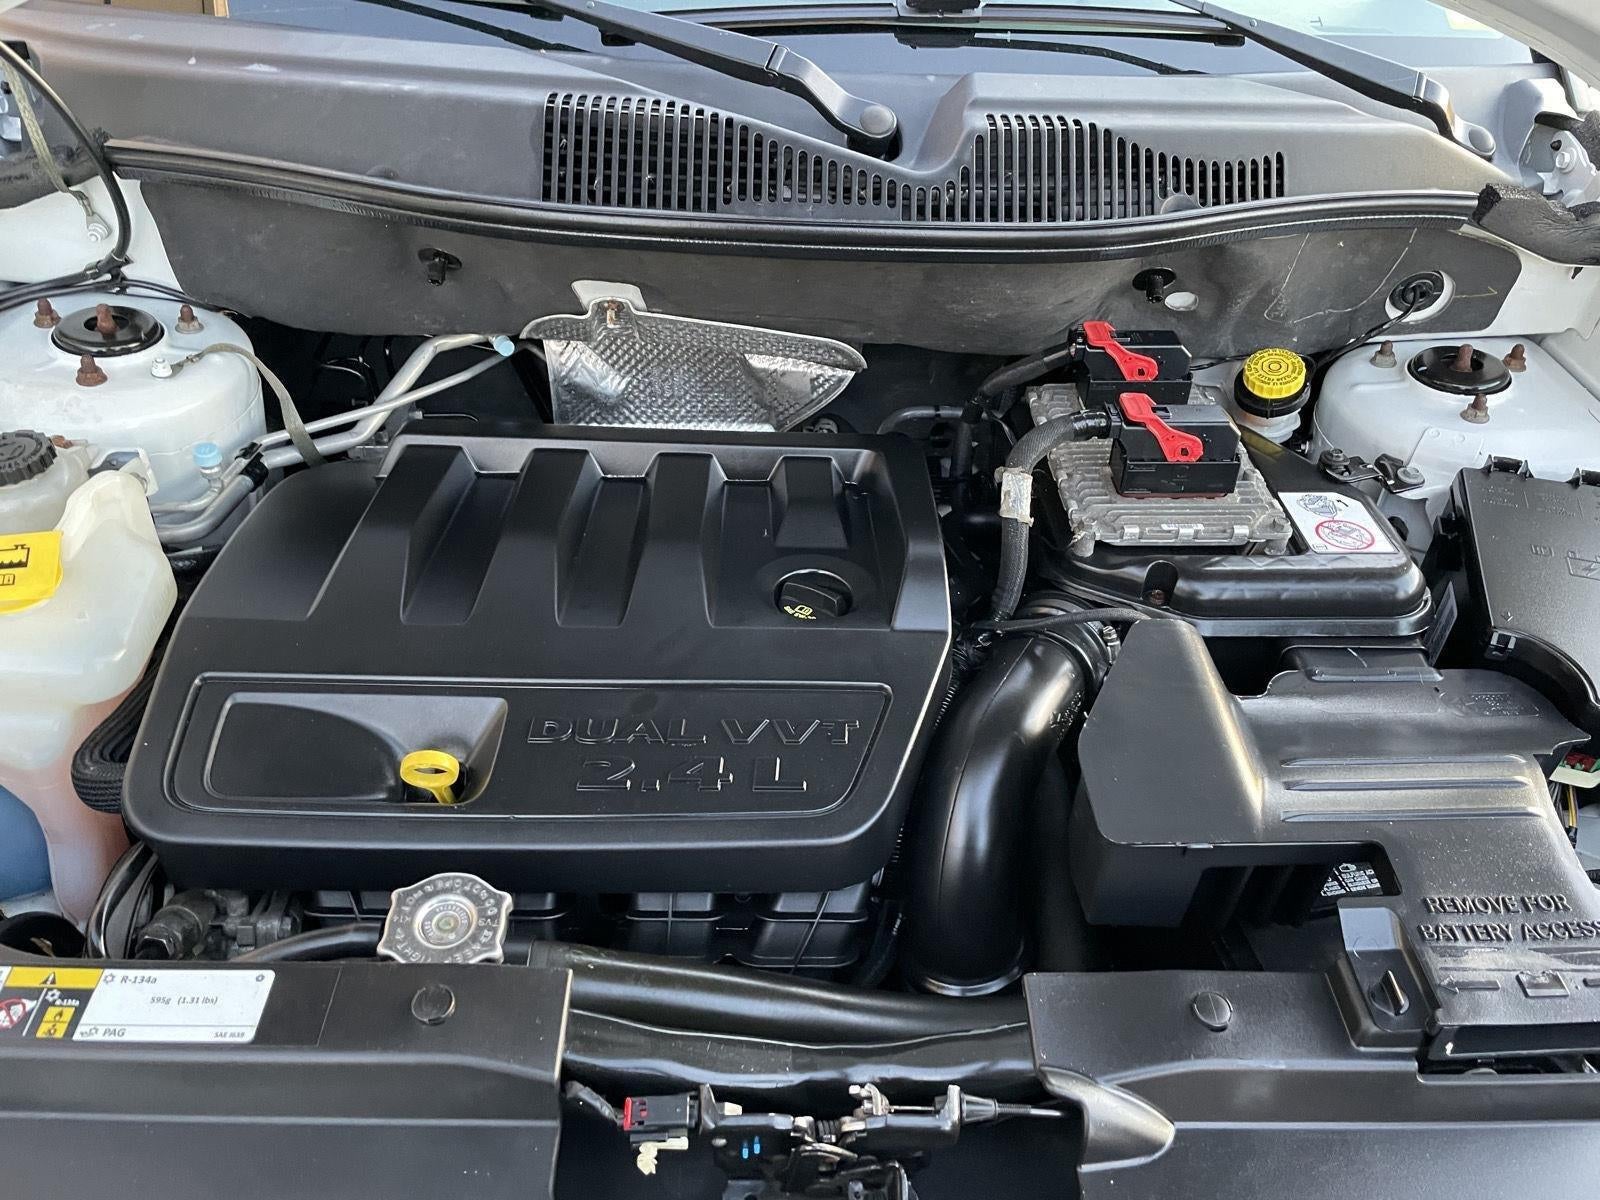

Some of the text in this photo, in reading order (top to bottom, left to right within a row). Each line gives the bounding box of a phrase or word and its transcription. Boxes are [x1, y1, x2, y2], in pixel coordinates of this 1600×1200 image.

[527, 718, 860, 745] DUAL VVT
[1423, 894, 1573, 915] REMOVE FOR
[1418, 923, 1516, 943] BATTERY
[120, 974, 157, 985] R-134a
[149, 996, 219, 1006] 595g (1.31 lbs)
[102, 1028, 127, 1038] PAG
